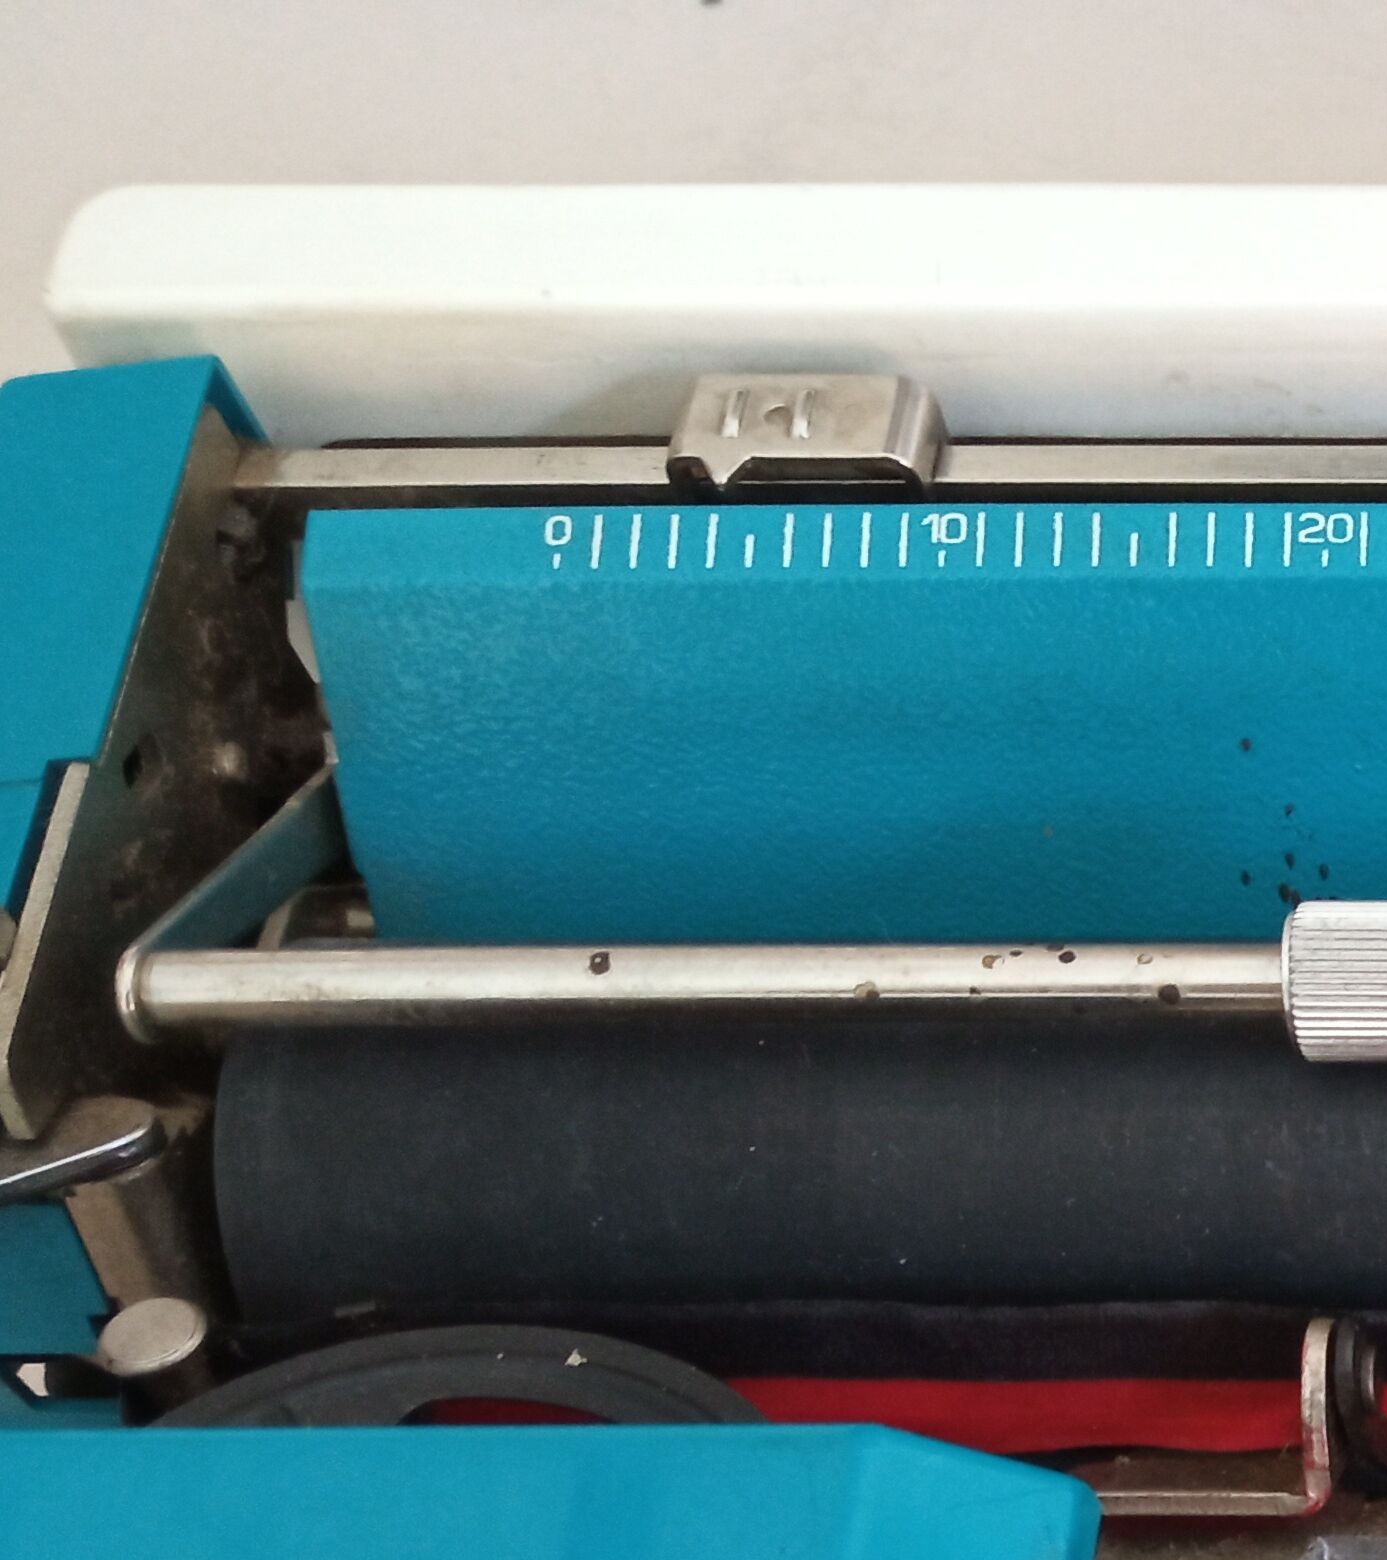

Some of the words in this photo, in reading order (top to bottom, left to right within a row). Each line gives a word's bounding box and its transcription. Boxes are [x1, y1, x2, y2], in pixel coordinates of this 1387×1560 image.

[544, 514, 573, 546] 0
[919, 513, 969, 545] 10
[1298, 511, 1355, 545] 20
